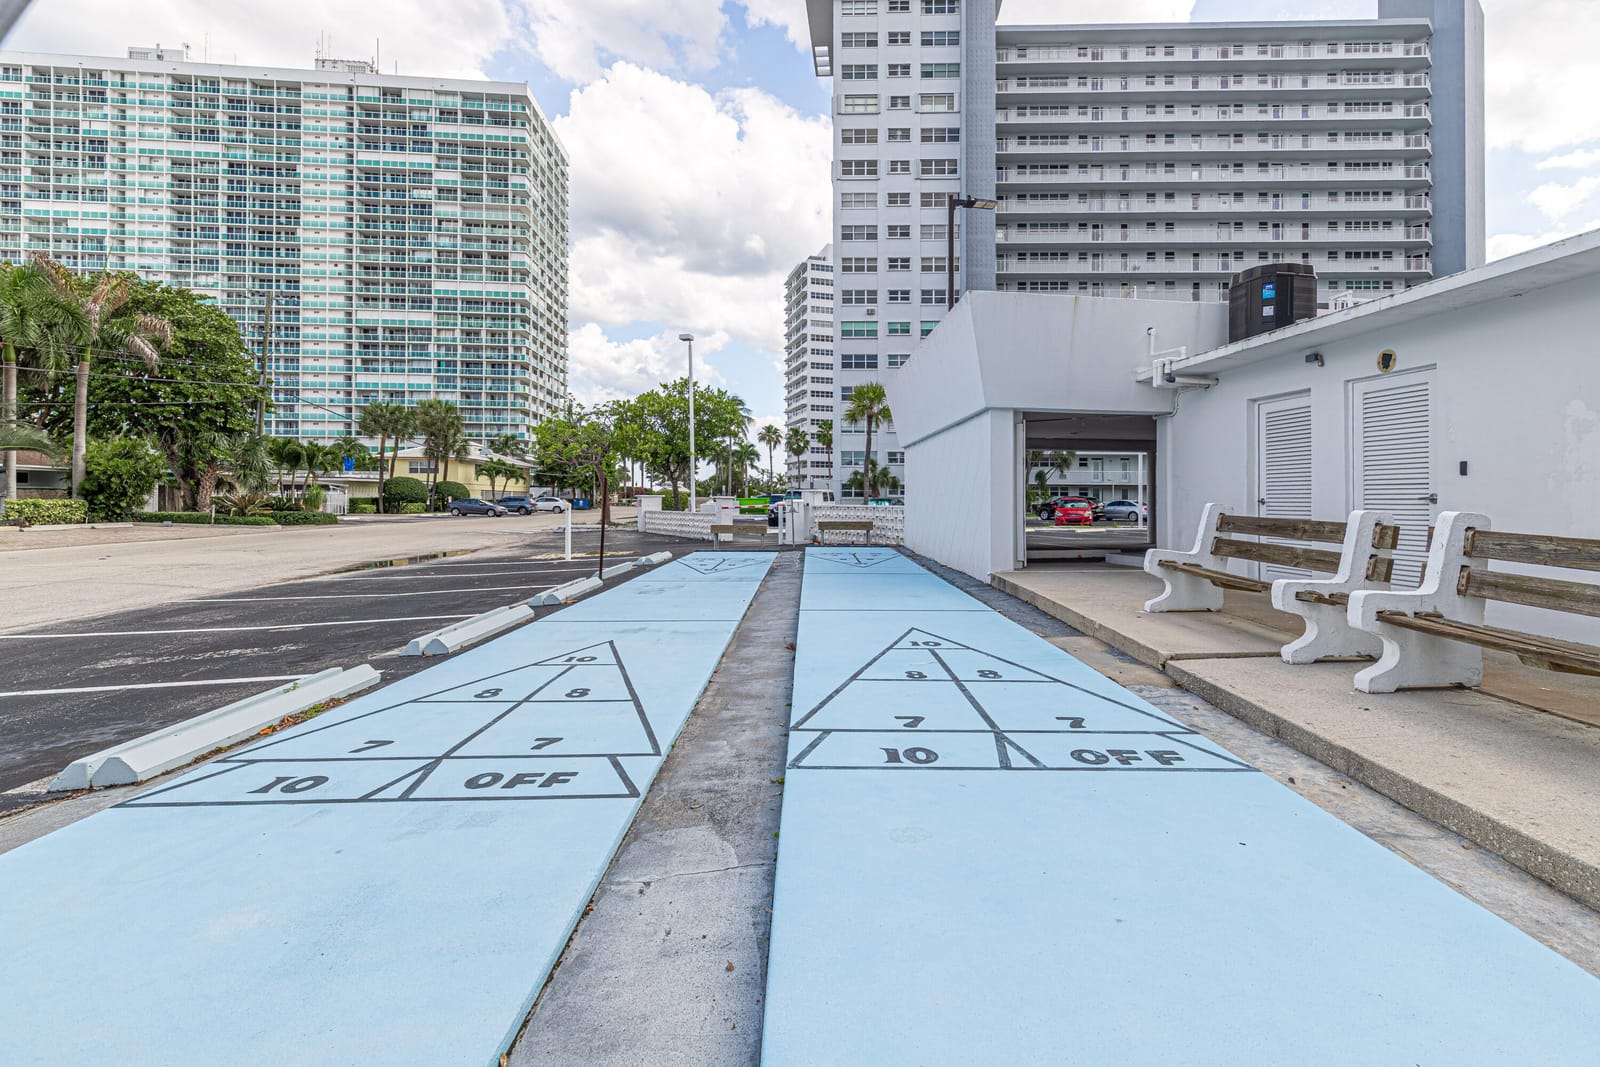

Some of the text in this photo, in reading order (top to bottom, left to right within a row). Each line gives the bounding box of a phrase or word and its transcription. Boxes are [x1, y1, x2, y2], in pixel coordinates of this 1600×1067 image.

[904, 670, 928, 679] 8
[976, 669, 1003, 679] 8
[473, 687, 504, 699] 8
[564, 687, 591, 699] 8
[894, 715, 925, 729] 7
[1055, 716, 1087, 729] 7
[347, 739, 395, 754] 7
[530, 737, 564, 751] 7
[880, 746, 940, 765] 10
[1069, 748, 1185, 766] OFF
[246, 775, 330, 794] 10
[463, 771, 580, 790] OFF
